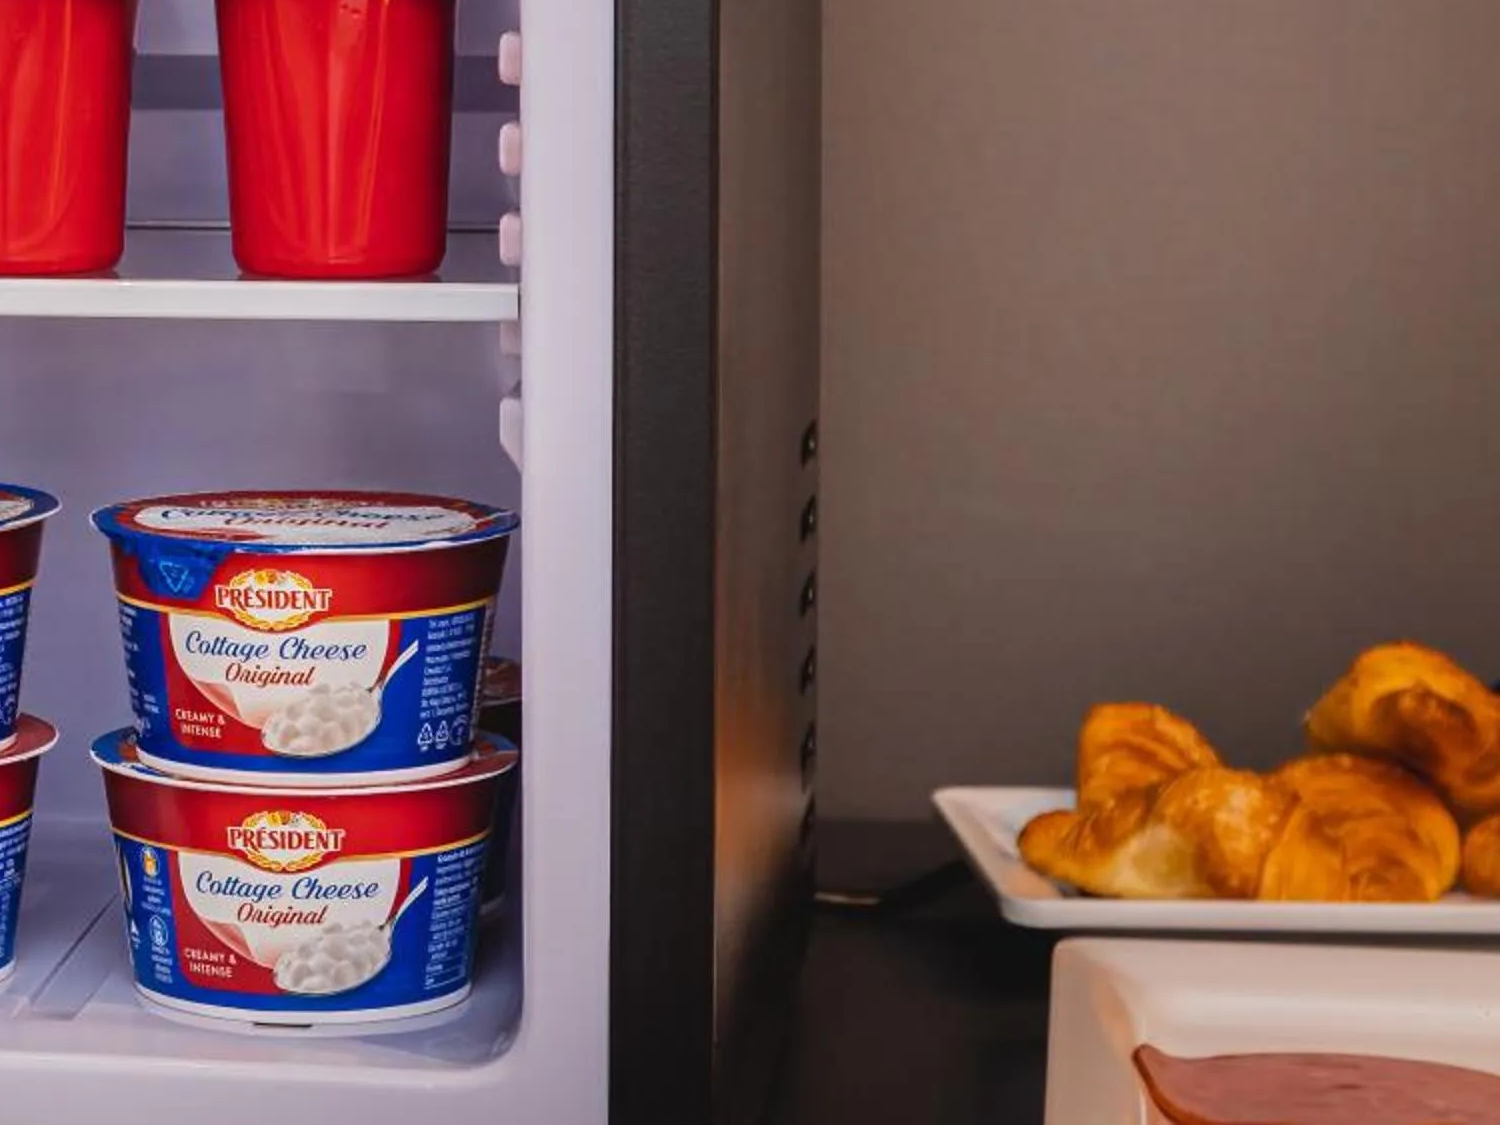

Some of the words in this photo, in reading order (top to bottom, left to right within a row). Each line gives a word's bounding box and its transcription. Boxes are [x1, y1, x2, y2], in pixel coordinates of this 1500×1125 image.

[216, 583, 331, 611] PRÉSIDENT
[185, 629, 269, 663] Cottage
[278, 635, 368, 661] Cheese
[224, 662, 315, 690] Original
[174, 708, 215, 724] CREAMY
[181, 723, 222, 739] INTENSE
[229, 825, 345, 852] PRÉSIDENT
[195, 869, 283, 904] Cottage
[290, 876, 380, 900] Cheese
[237, 902, 329, 930] Original
[184, 947, 226, 964] CREAMY
[227, 952, 237, 964] &
[189, 961, 234, 978] INTENSE
